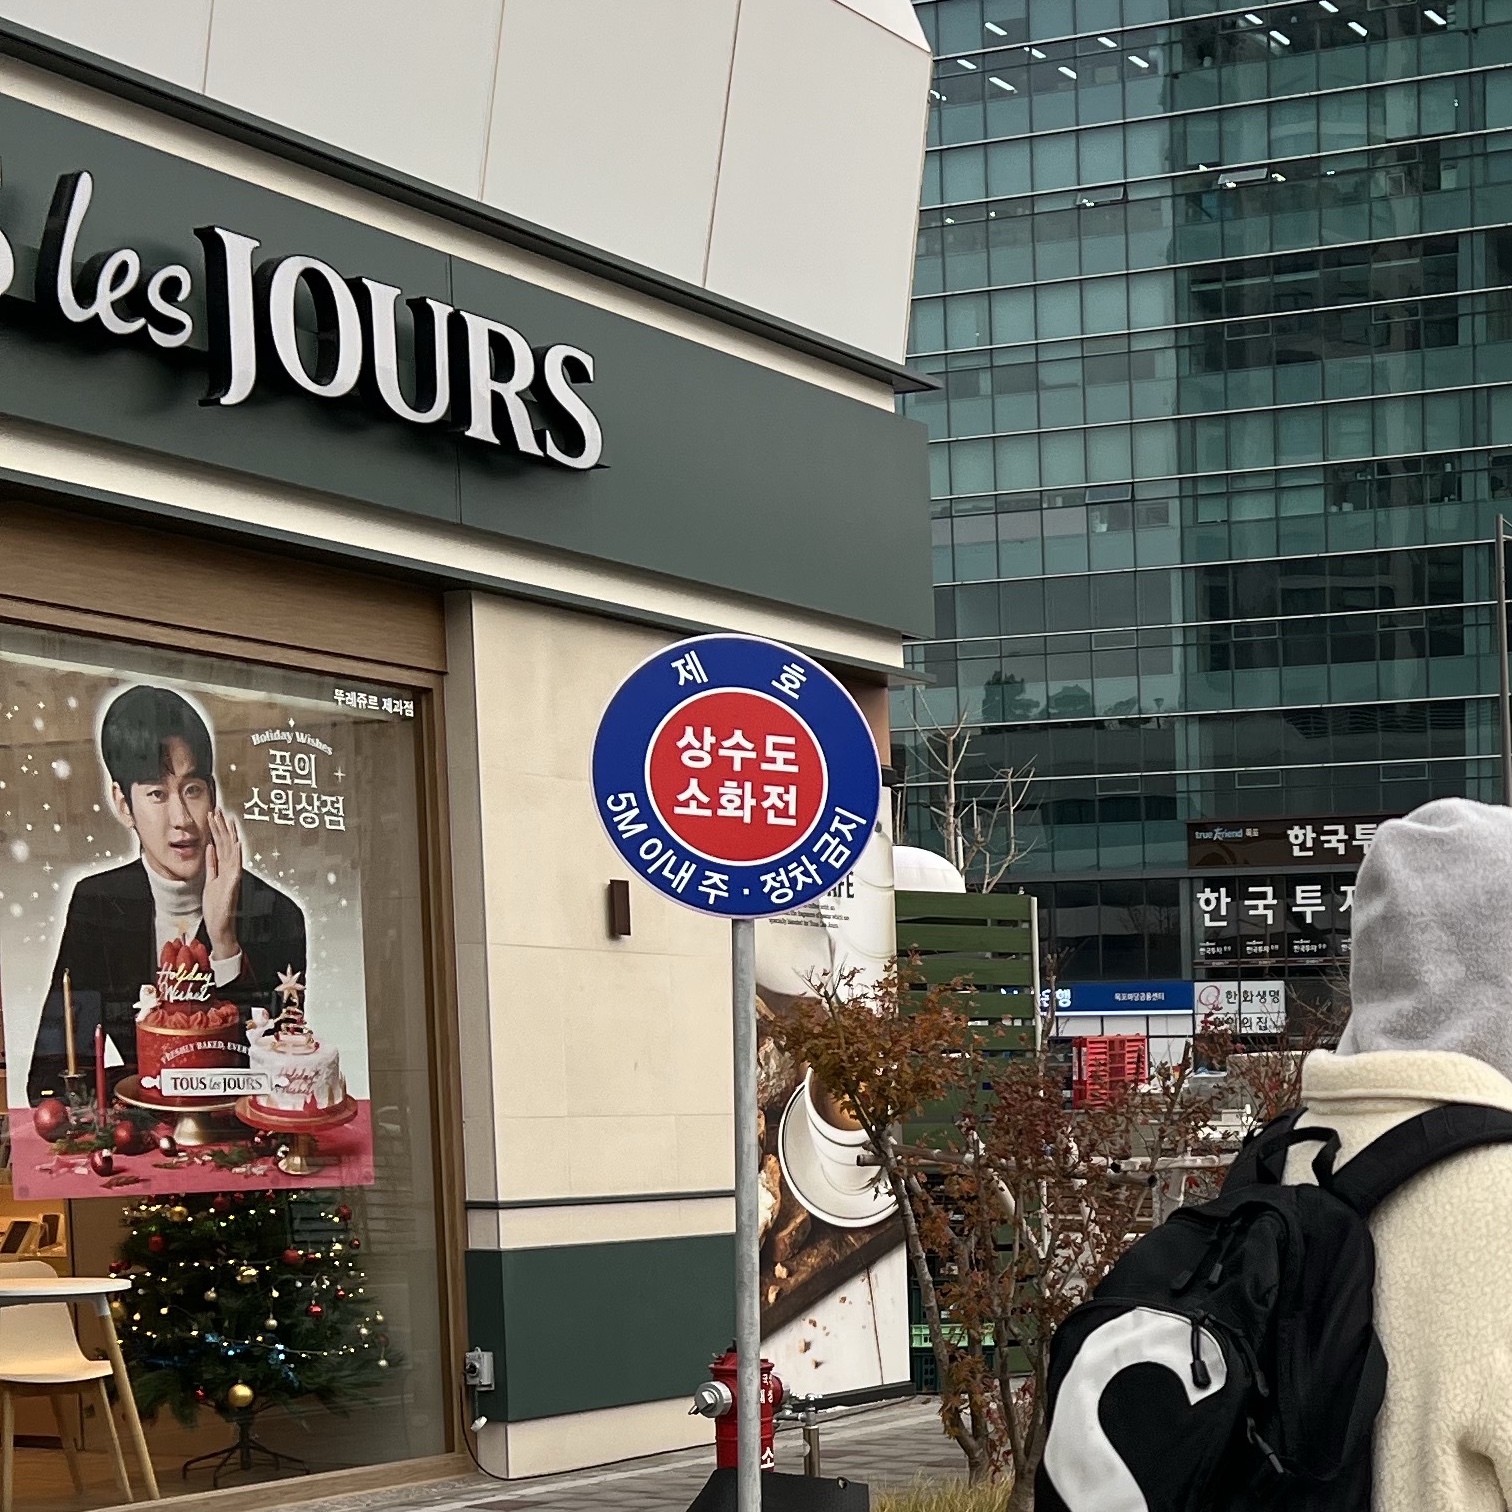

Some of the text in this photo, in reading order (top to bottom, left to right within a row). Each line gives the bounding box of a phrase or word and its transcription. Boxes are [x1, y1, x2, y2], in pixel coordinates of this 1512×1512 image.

[57, 169, 604, 470] les JOURS
[671, 650, 807, 700] 제 호
[333, 688, 415, 718] 뚜레쥬르 제과점
[251, 728, 334, 756] Holiday Wishes
[676, 725, 800, 773] 상수도
[268, 748, 318, 789] 꿈의
[243, 787, 346, 832] 소원상점
[673, 777, 797, 827] 소화전
[606, 792, 648, 840] 5M
[639, 837, 698, 894] 이내
[812, 806, 867, 870] 금지
[1225, 989, 1281, 1004] 한화생명
[170, 1077, 207, 1091] TOUS
[222, 1076, 263, 1093] JOURS
